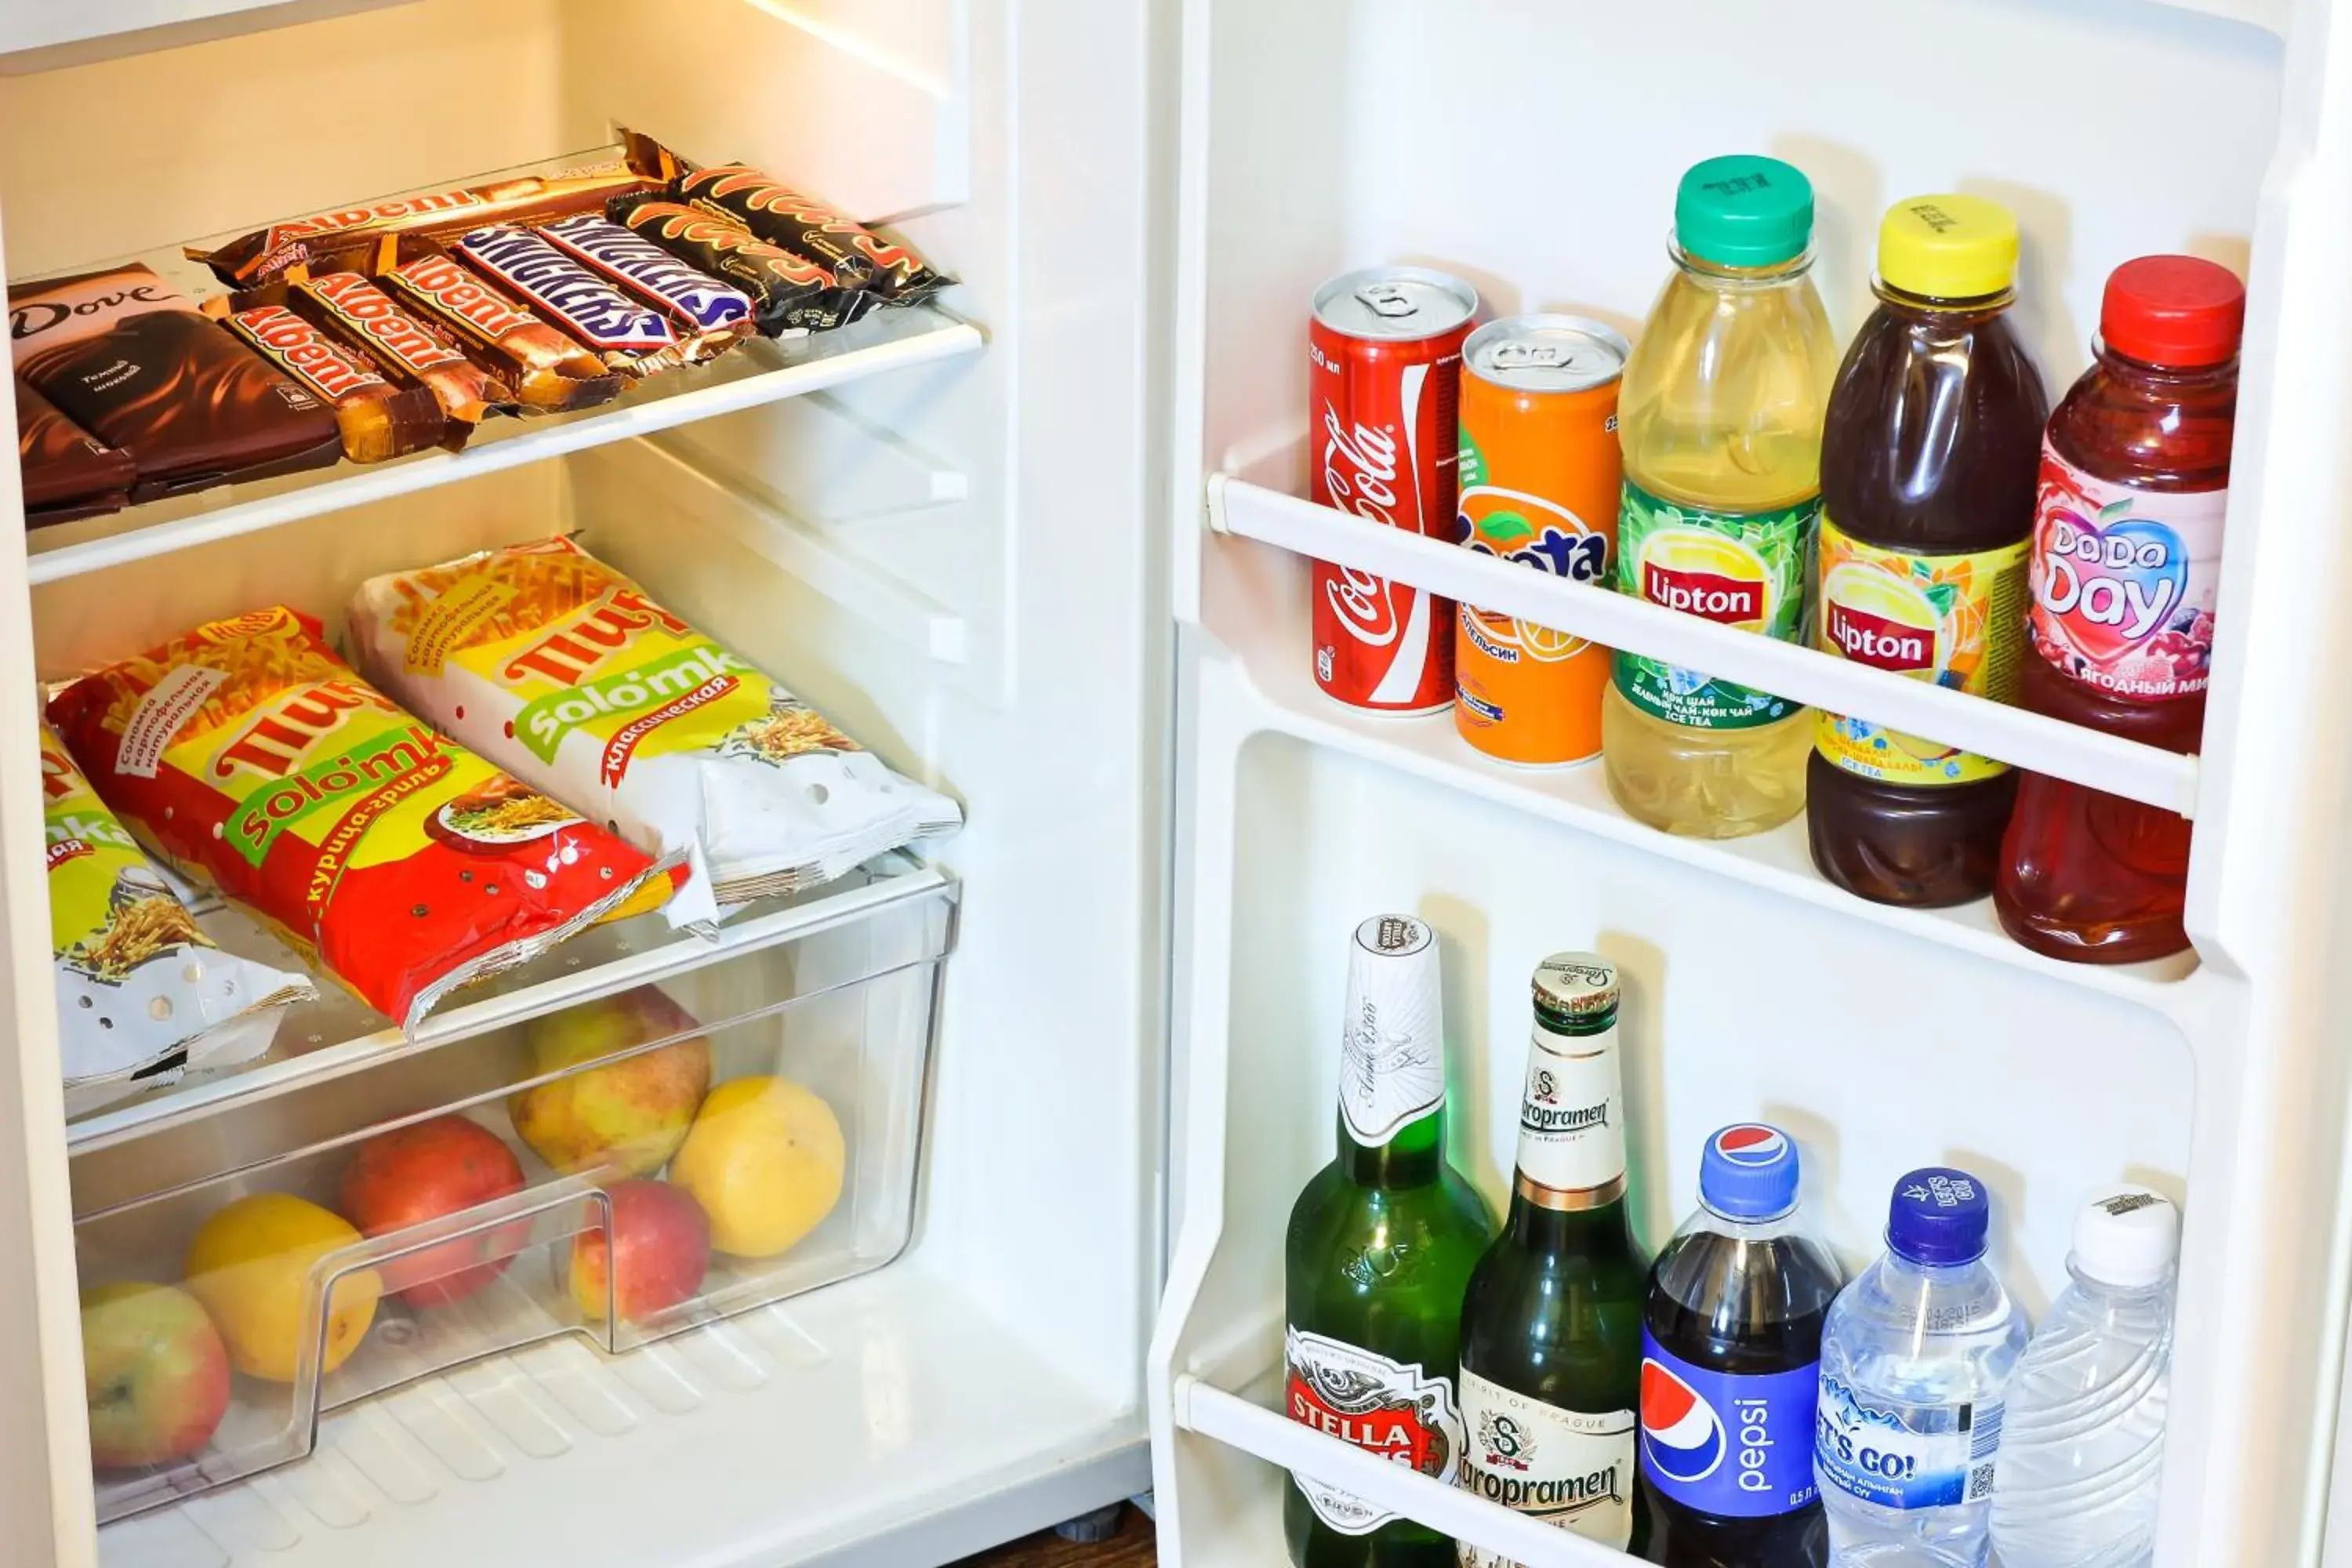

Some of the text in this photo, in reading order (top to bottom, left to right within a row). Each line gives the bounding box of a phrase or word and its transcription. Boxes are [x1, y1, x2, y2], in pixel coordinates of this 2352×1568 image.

[462, 226, 668, 340] SNICKERS
[9, 285, 184, 340] Dove
[310, 271, 466, 370] Albeni
[237, 306, 385, 398] Albeni
[1324, 396, 1399, 647] CocCola
[1651, 569, 1751, 614] Lipton
[2044, 550, 2175, 641] Day
[1831, 608, 1922, 661] Lipton
[2079, 666, 2176, 696] ЯГОДНЫЙ
[120, 697, 157, 766] Соломка
[1664, 710, 1712, 727] ICE TEA
[1730, 704, 1753, 717] ЧАЙ
[306, 761, 441, 903] курица-гриль
[1522, 1098, 1608, 1130] aropramen
[1294, 1391, 1413, 1447] STELLA
[1538, 1410, 1606, 1429] PRAGUE
[1733, 1398, 1775, 1493] pepsi
[1459, 1460, 1624, 1508] aropramen
